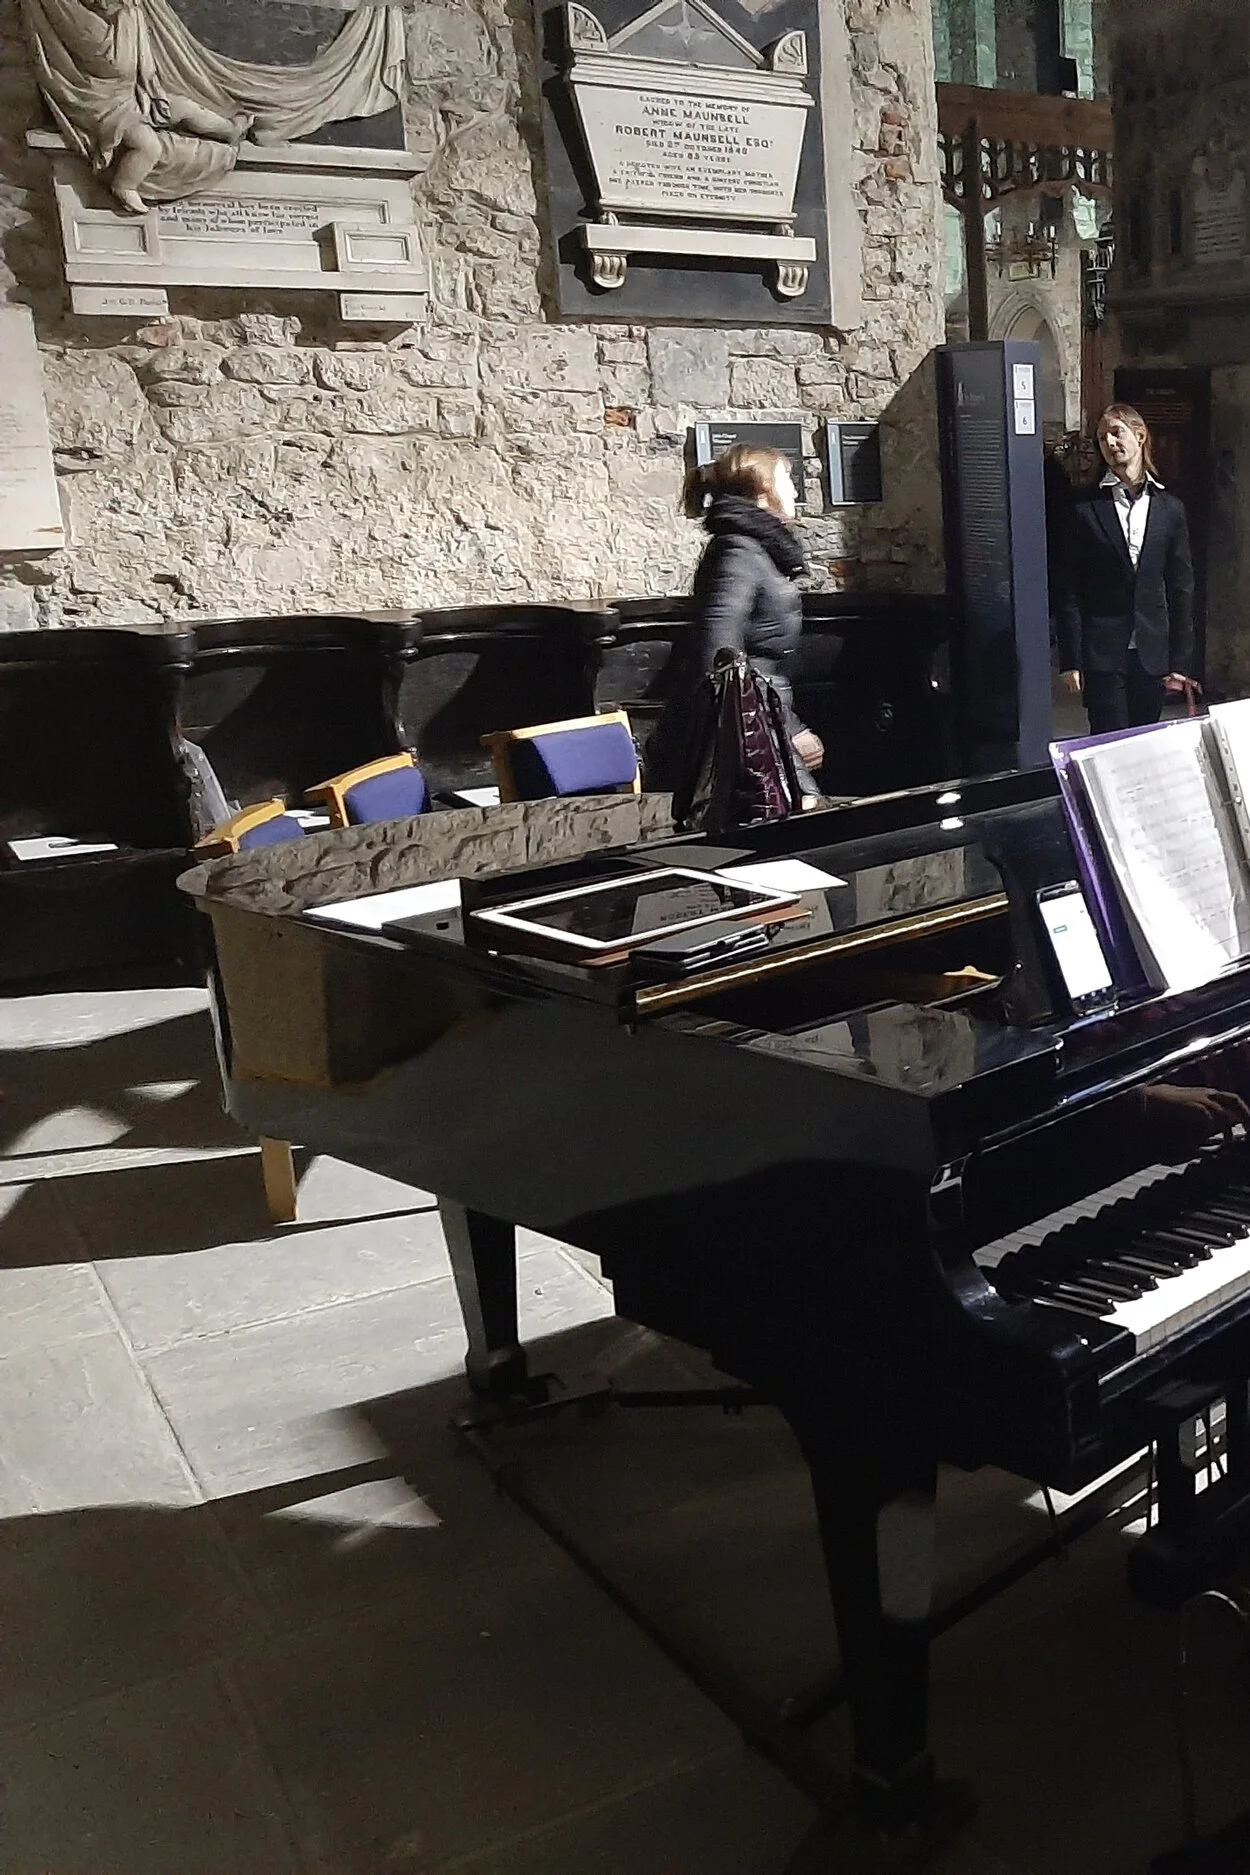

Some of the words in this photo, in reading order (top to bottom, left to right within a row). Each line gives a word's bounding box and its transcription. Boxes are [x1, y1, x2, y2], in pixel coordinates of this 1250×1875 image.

[642, 106, 678, 118] ANNE
[682, 109, 750, 126] MAUNSELL
[615, 124, 666, 140] ROBERT
[672, 130, 740, 146] MAUNSELL
